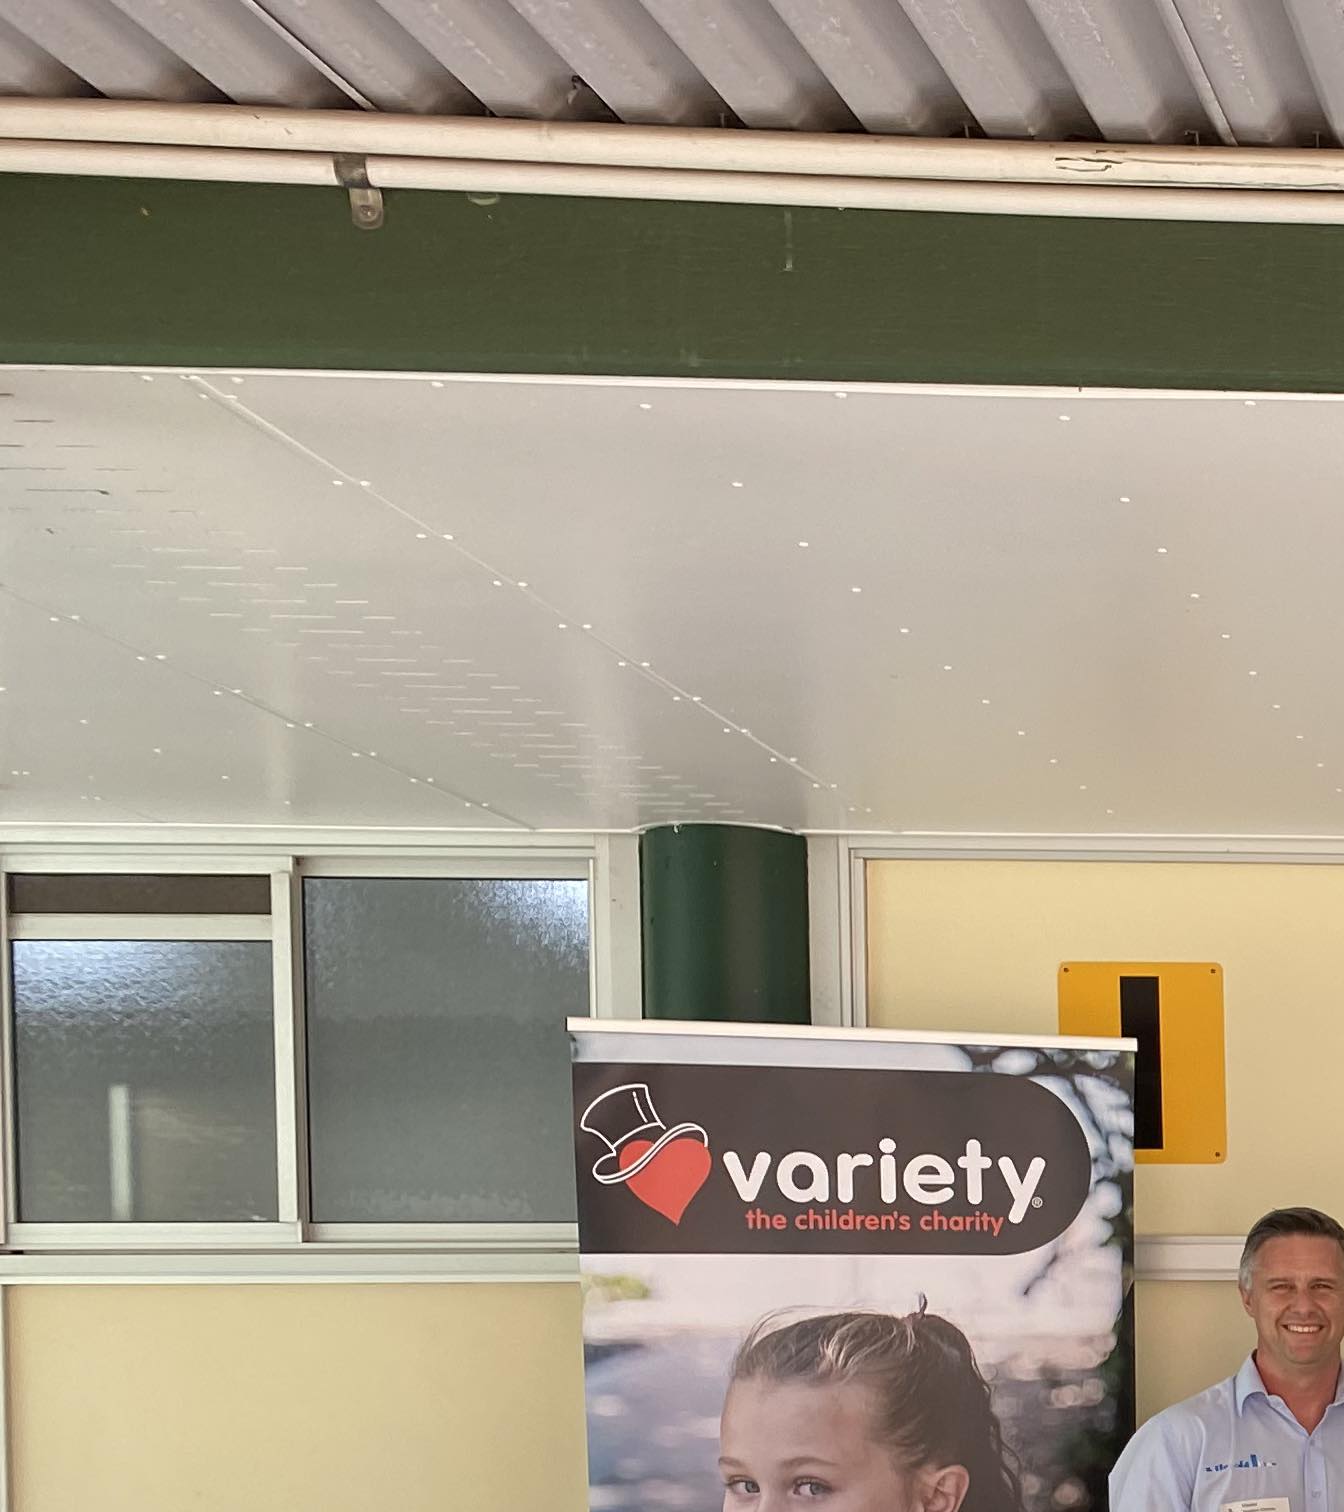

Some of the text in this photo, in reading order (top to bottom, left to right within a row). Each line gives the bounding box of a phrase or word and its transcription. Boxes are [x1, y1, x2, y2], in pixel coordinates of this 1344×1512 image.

[722, 1138, 1046, 1224] variety
[746, 1209, 1003, 1237] the children's charity
